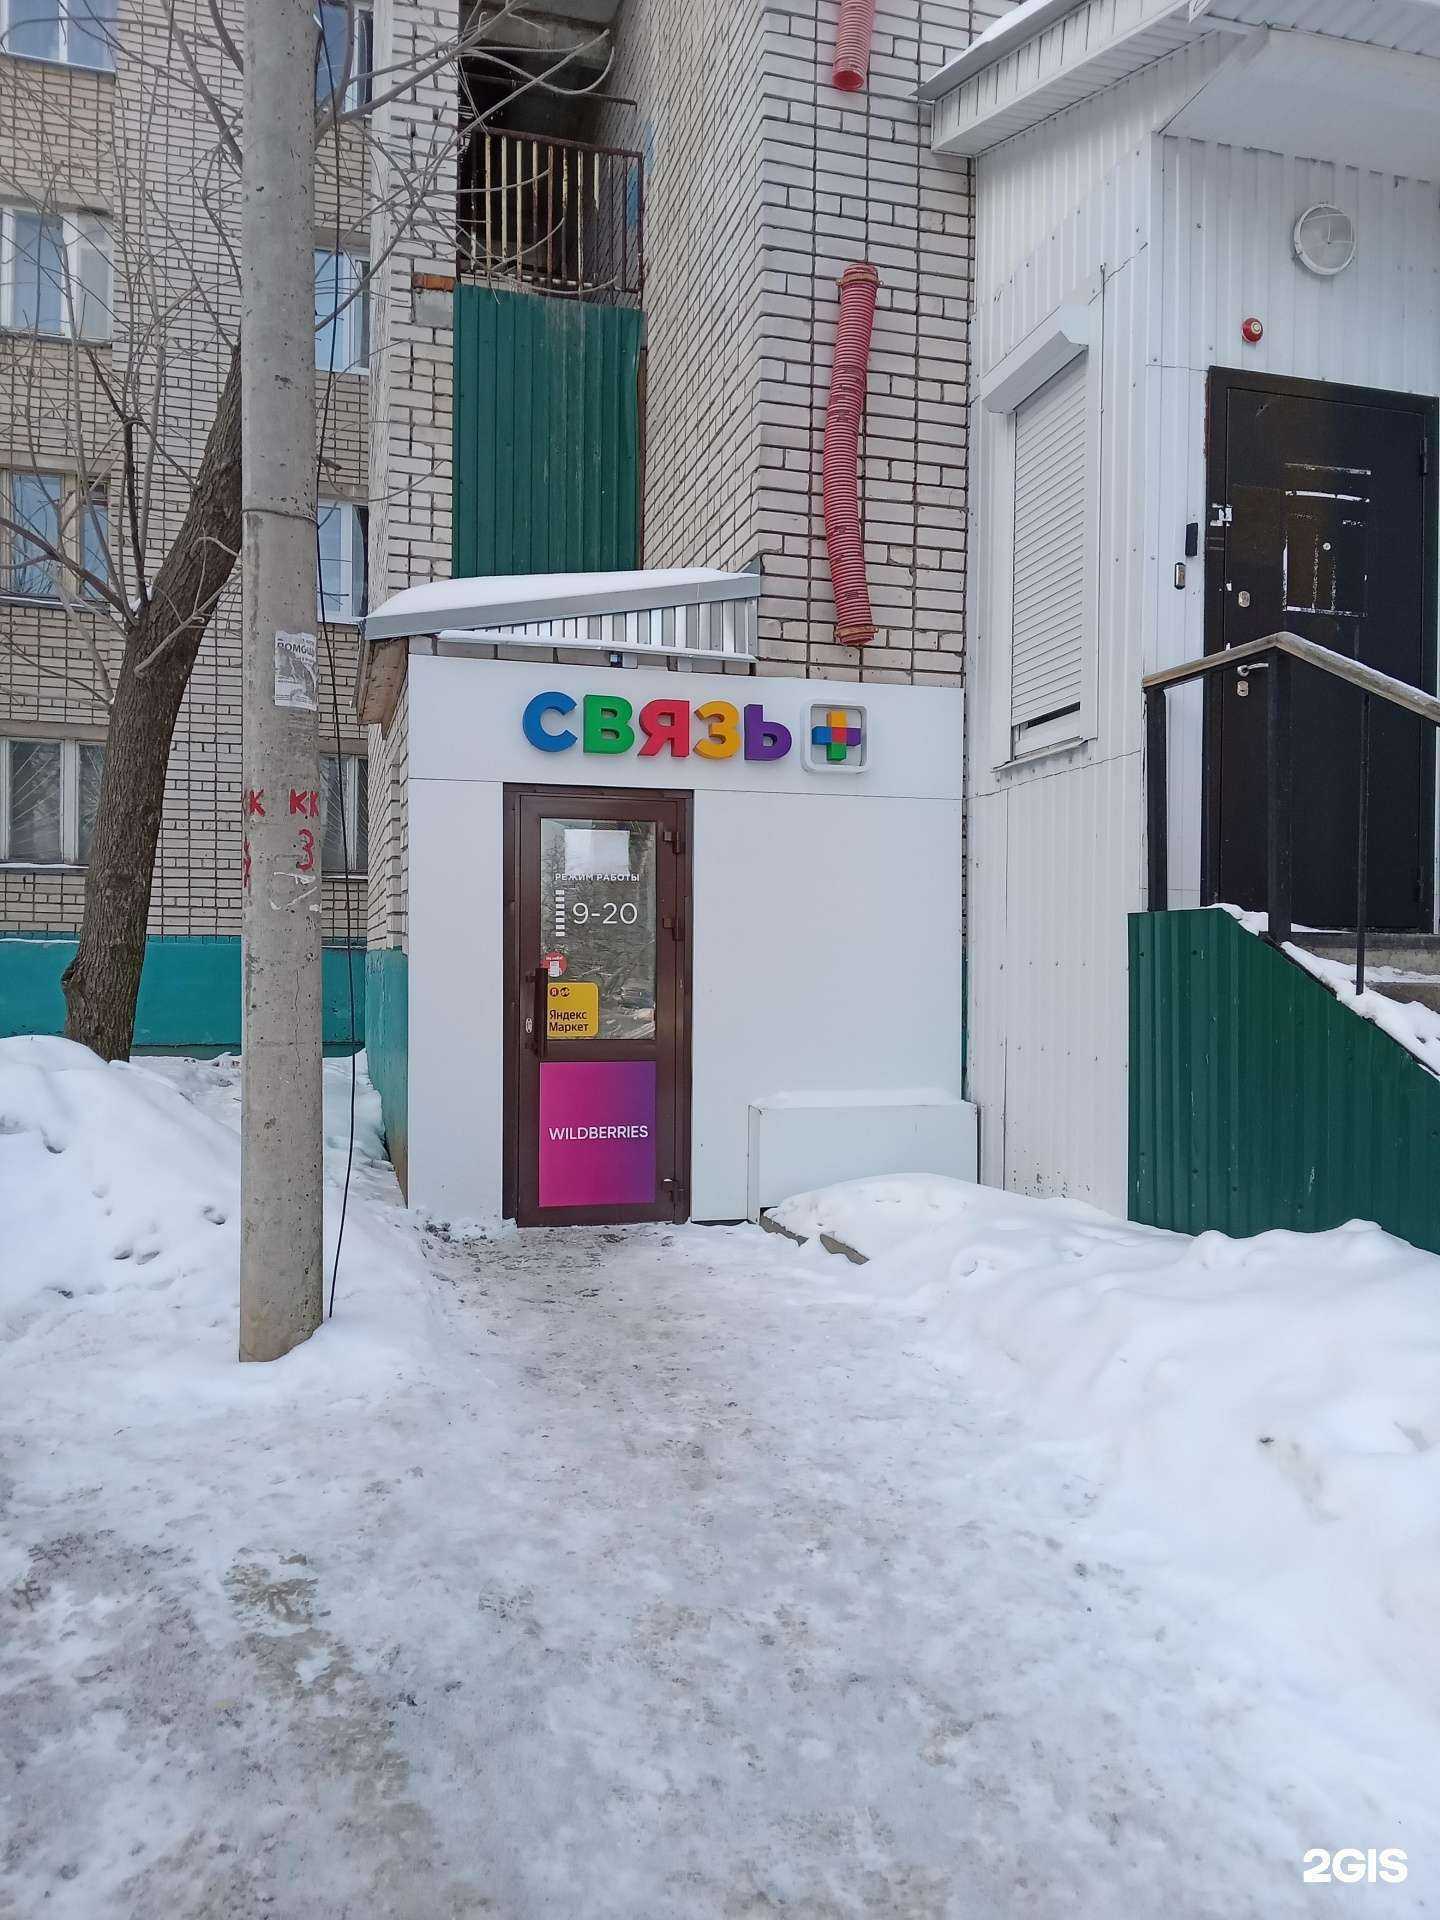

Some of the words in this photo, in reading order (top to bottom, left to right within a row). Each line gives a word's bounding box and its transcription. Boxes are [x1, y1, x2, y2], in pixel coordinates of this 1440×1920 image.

[522, 691, 793, 761] СВЯЗЬ
[555, 873, 594, 881] РЕЖИМ
[596, 873, 640, 881] РАБОТЫ
[572, 902, 638, 925] 9-20
[549, 1009, 587, 1020] Яндекс
[549, 1022, 589, 1033] Маркет
[548, 1125, 649, 1140] WILDBERRIES
